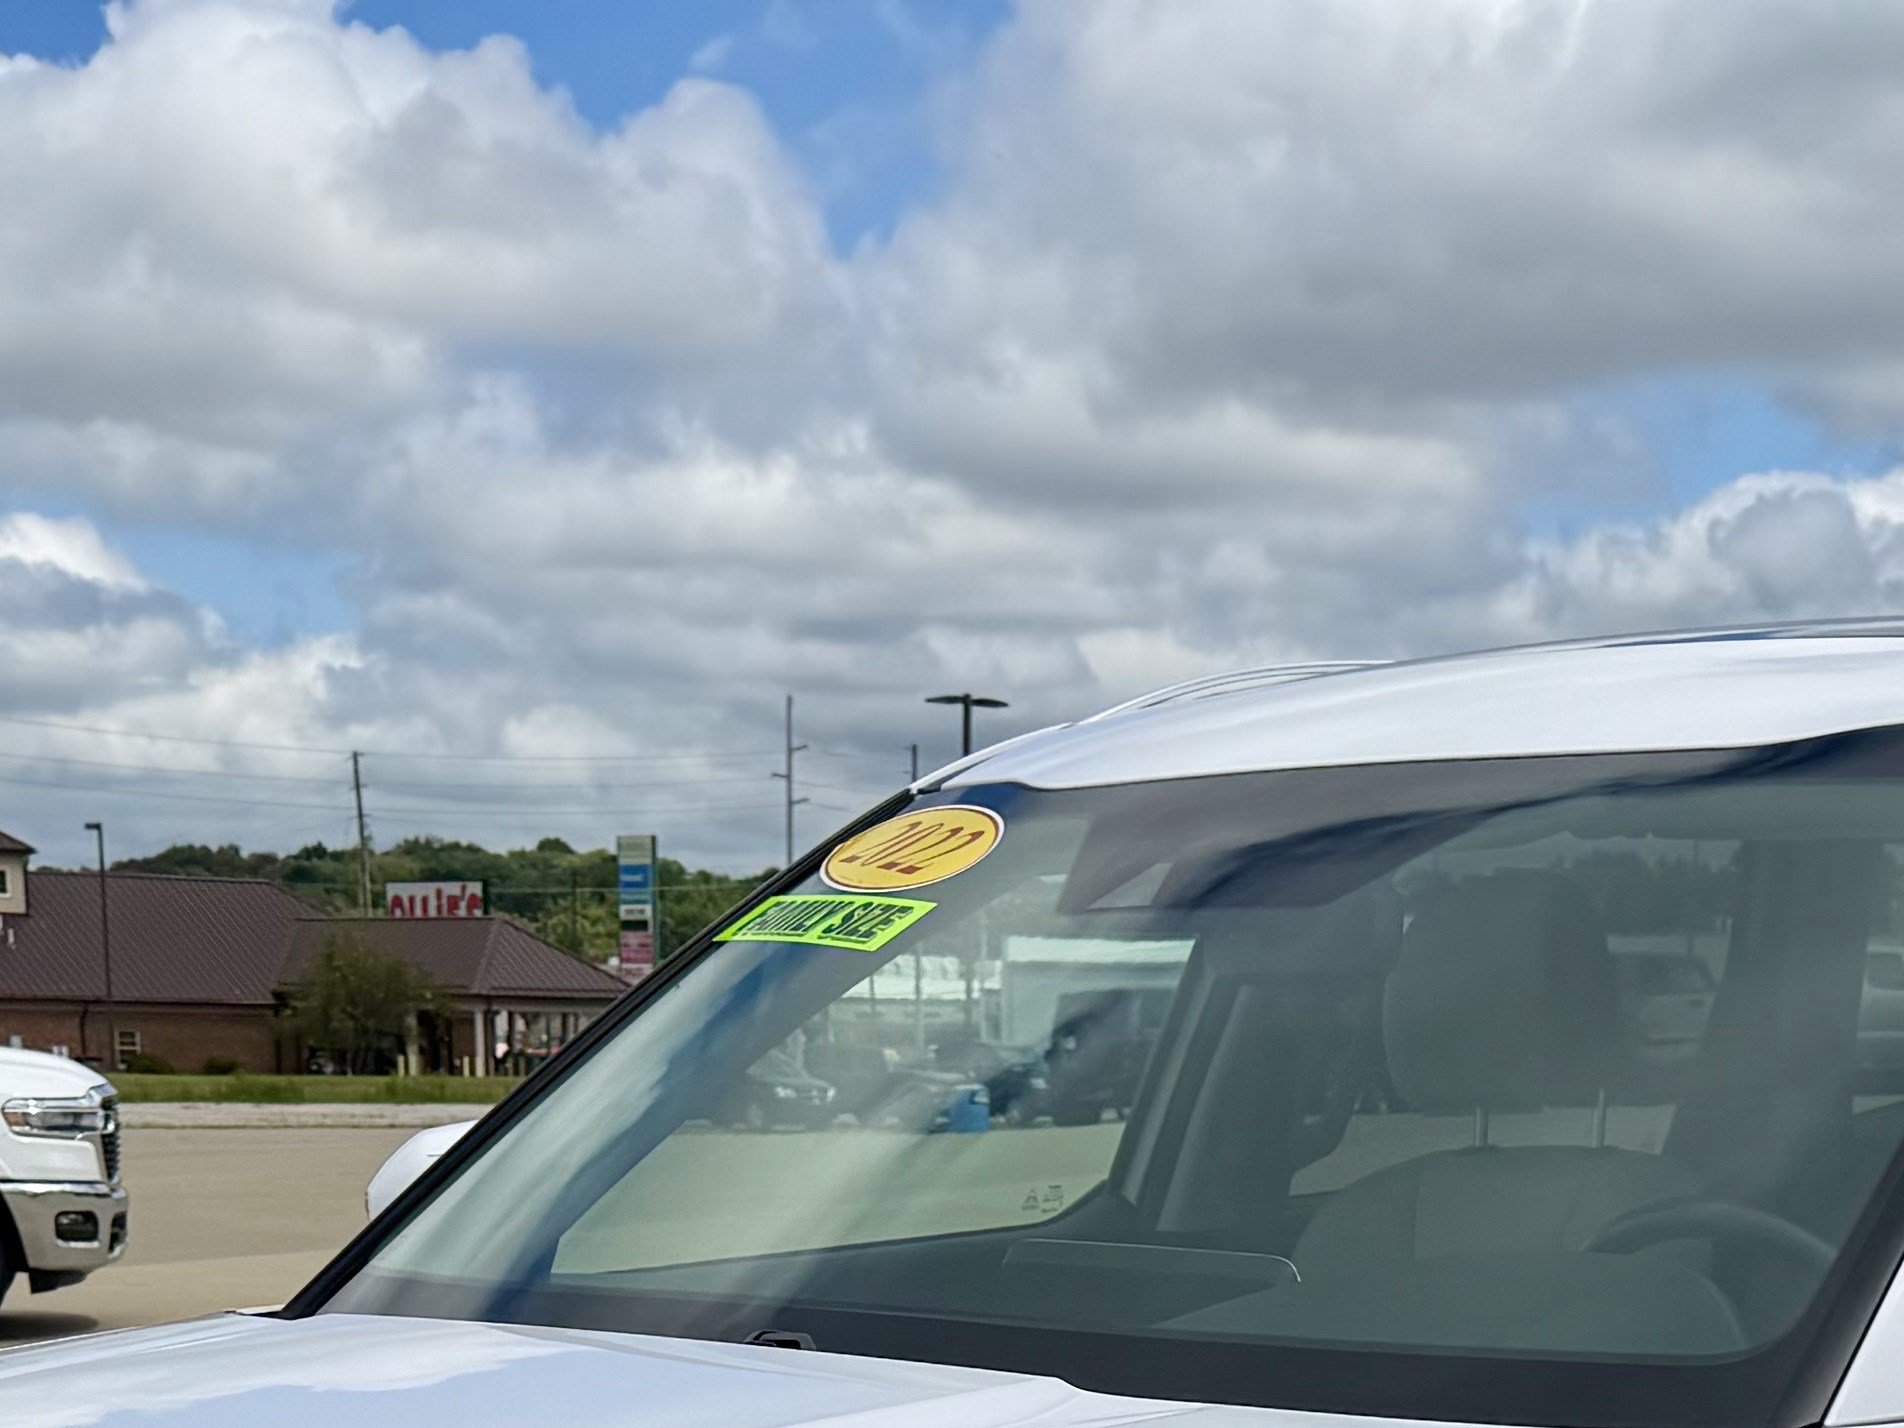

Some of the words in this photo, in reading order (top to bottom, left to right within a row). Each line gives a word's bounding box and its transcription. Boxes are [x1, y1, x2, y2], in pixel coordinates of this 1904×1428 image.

[839, 820, 986, 875] 2022
[733, 900, 853, 936] FAMILY
[817, 901, 915, 942] SIZE
